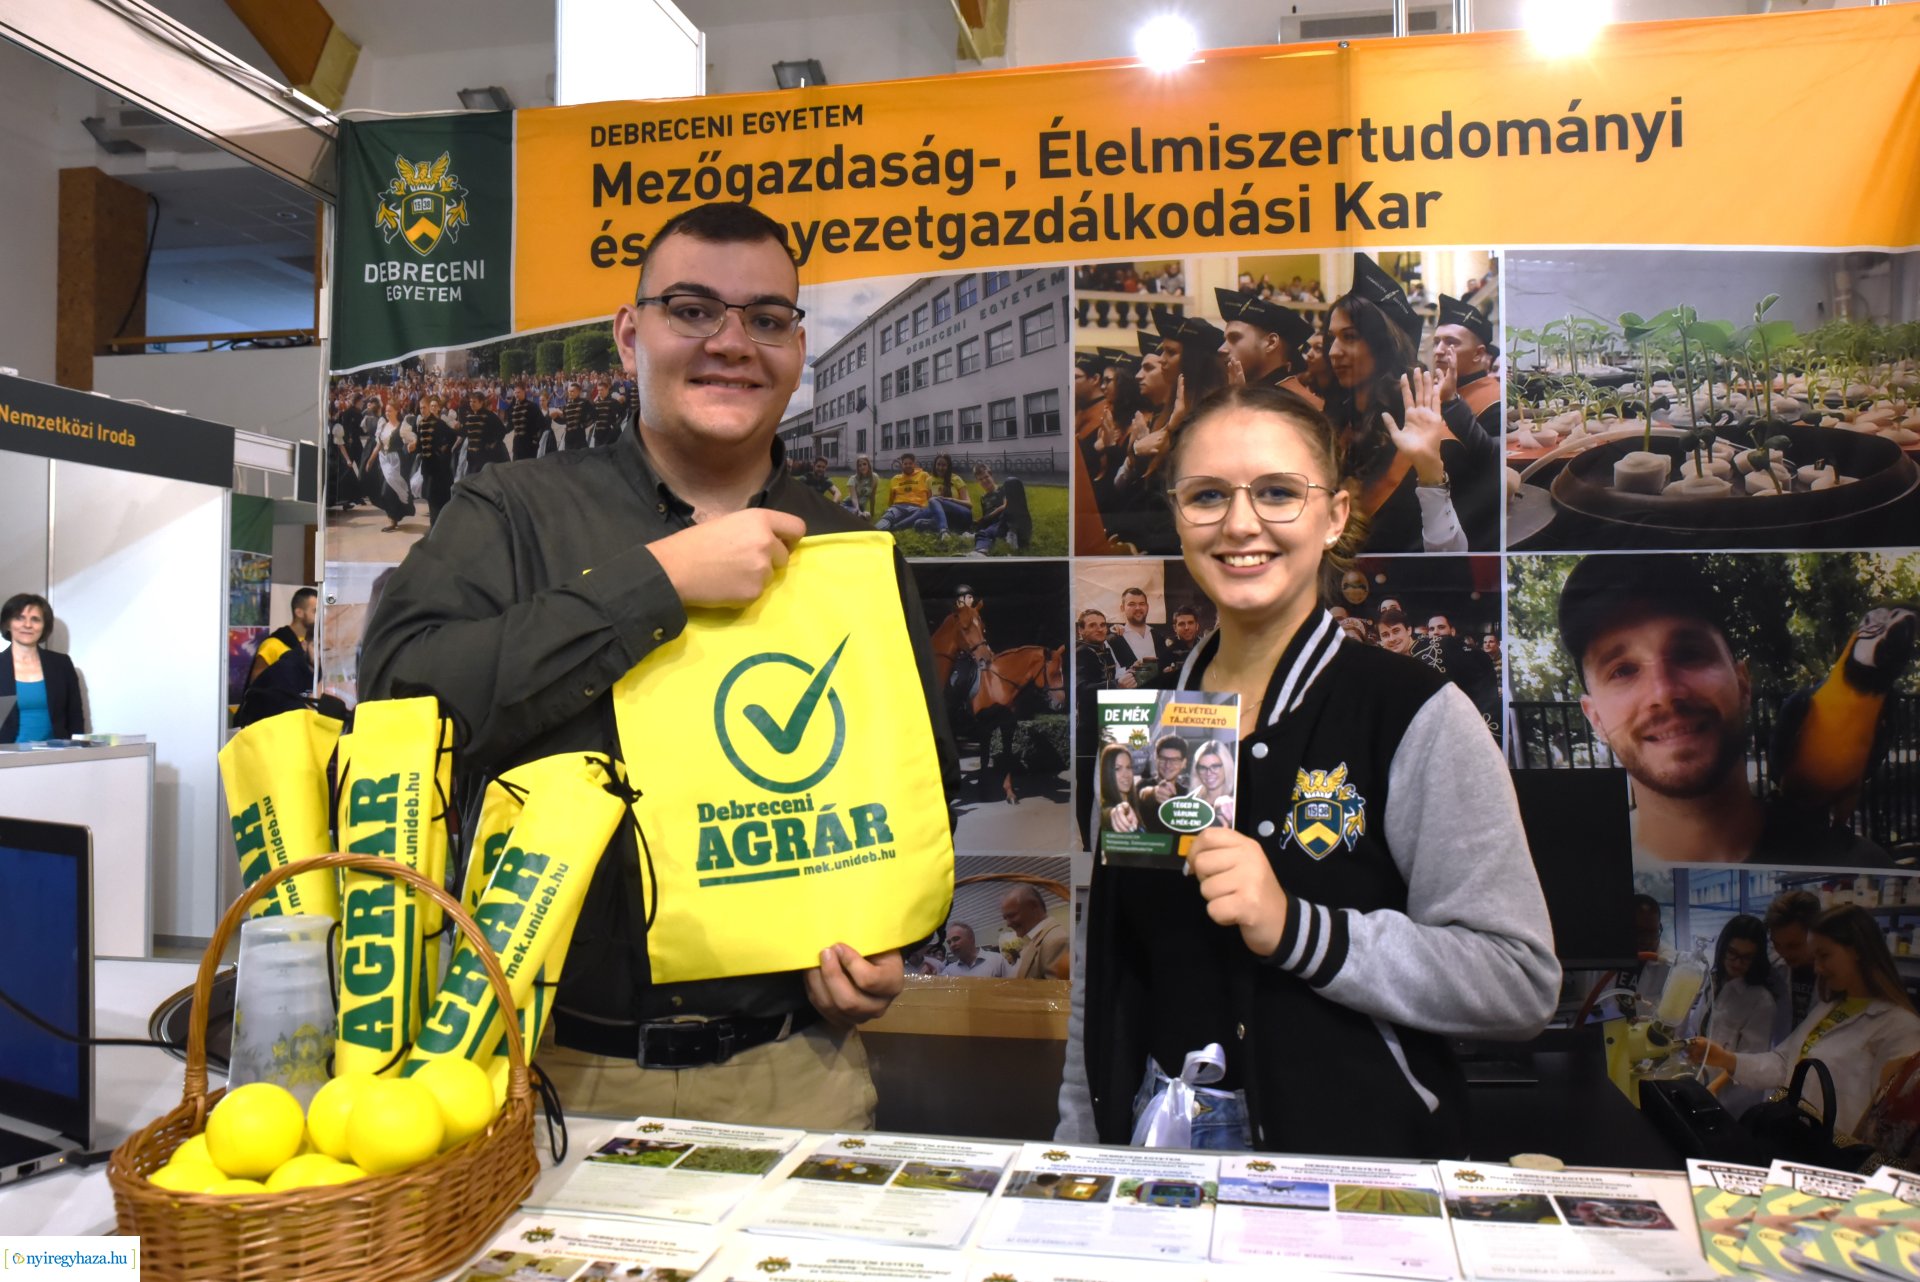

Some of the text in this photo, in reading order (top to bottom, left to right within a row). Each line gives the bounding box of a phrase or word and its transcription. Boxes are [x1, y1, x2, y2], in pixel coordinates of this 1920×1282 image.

[590, 104, 864, 148] DEBRECENI EGYETEM
[591, 97, 1684, 207] Mezőgazdaság-, Élelmiszertudományi
[590, 219, 645, 269] és
[1334, 180, 1443, 234] Kar
[364, 259, 486, 284] DEBRECENI
[386, 284, 463, 303] EGYETEM
[906, 267, 1066, 356] DEBRECENI EGYETEM
[0, 404, 136, 447] Nemzetközi Iroda
[1104, 706, 1151, 722] DE MÉK
[1173, 706, 1218, 715] FELVÉTELI
[696, 793, 814, 823] Debreceni
[696, 802, 894, 871] AGRÁR
[803, 847, 896, 876] mek.unideb.hu
[505, 862, 569, 979] mek.unideb.hu
